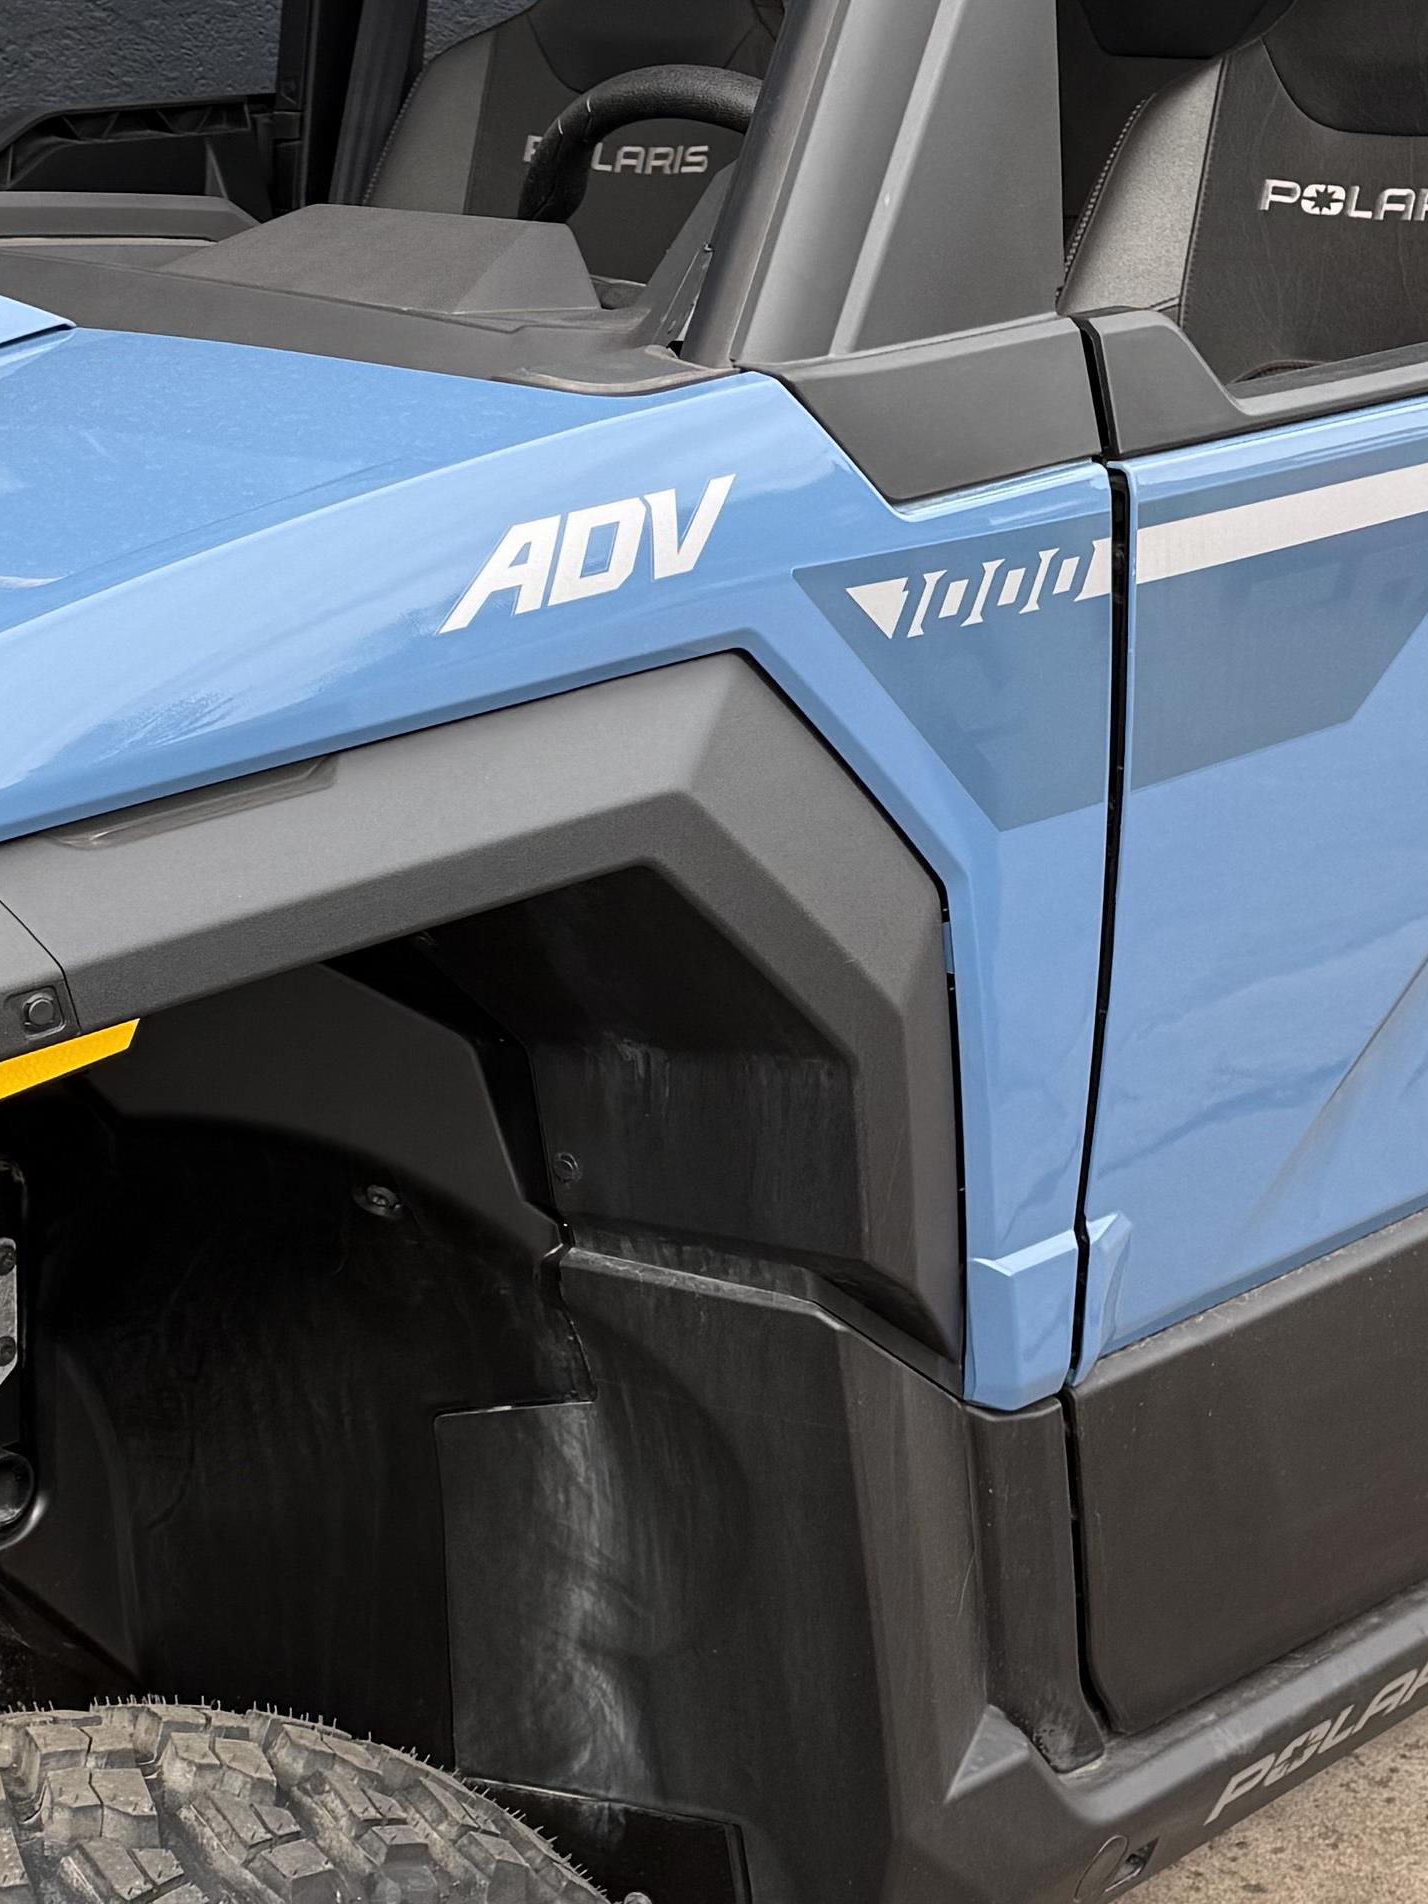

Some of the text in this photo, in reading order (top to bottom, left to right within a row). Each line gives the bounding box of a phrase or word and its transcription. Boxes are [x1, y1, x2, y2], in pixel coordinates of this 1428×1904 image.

[523, 133, 710, 175] PLARIS
[437, 473, 737, 636] ADV
[887, 543, 1096, 642] 1000
